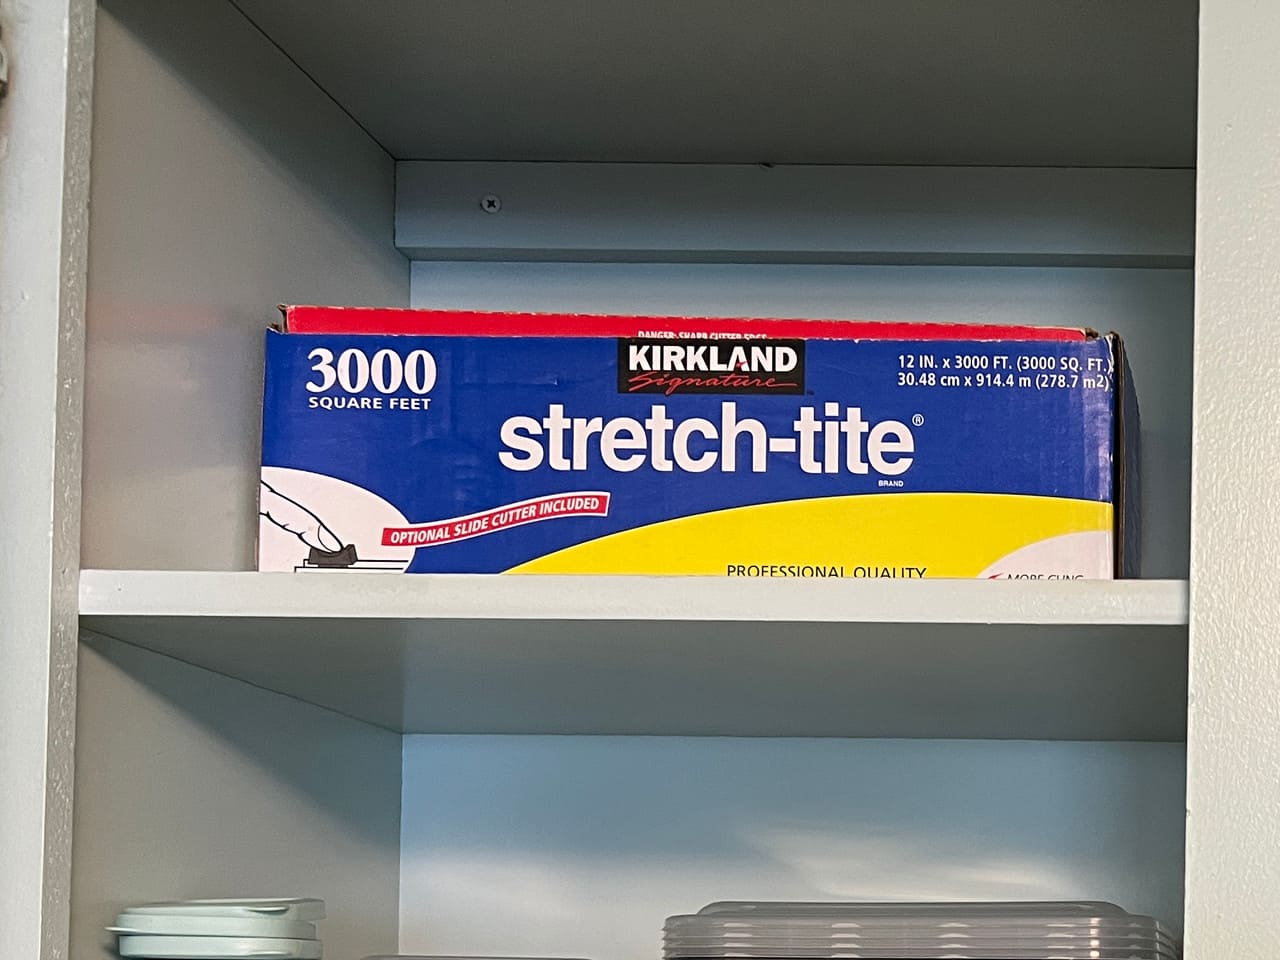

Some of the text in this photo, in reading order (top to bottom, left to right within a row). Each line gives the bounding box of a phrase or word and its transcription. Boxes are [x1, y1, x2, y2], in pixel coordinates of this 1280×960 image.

[629, 344, 798, 372] KIRKLAND
[898, 354, 1112, 373] 12 IN. x 3000 FT. (3000 SQ. FT.)
[305, 348, 437, 395] 3000
[628, 370, 798, 396] Signature
[897, 372, 1110, 392] 30.48 cm x 914.4 m (278.7 m2)
[308, 396, 432, 411] SQUARE FEET
[498, 403, 915, 475] stretch-tite
[878, 479, 904, 487] BRAND
[390, 497, 600, 544] OPTIONAL SLIDE CUTTER INCLUDED
[727, 564, 844, 577] PROFESSIONAL
